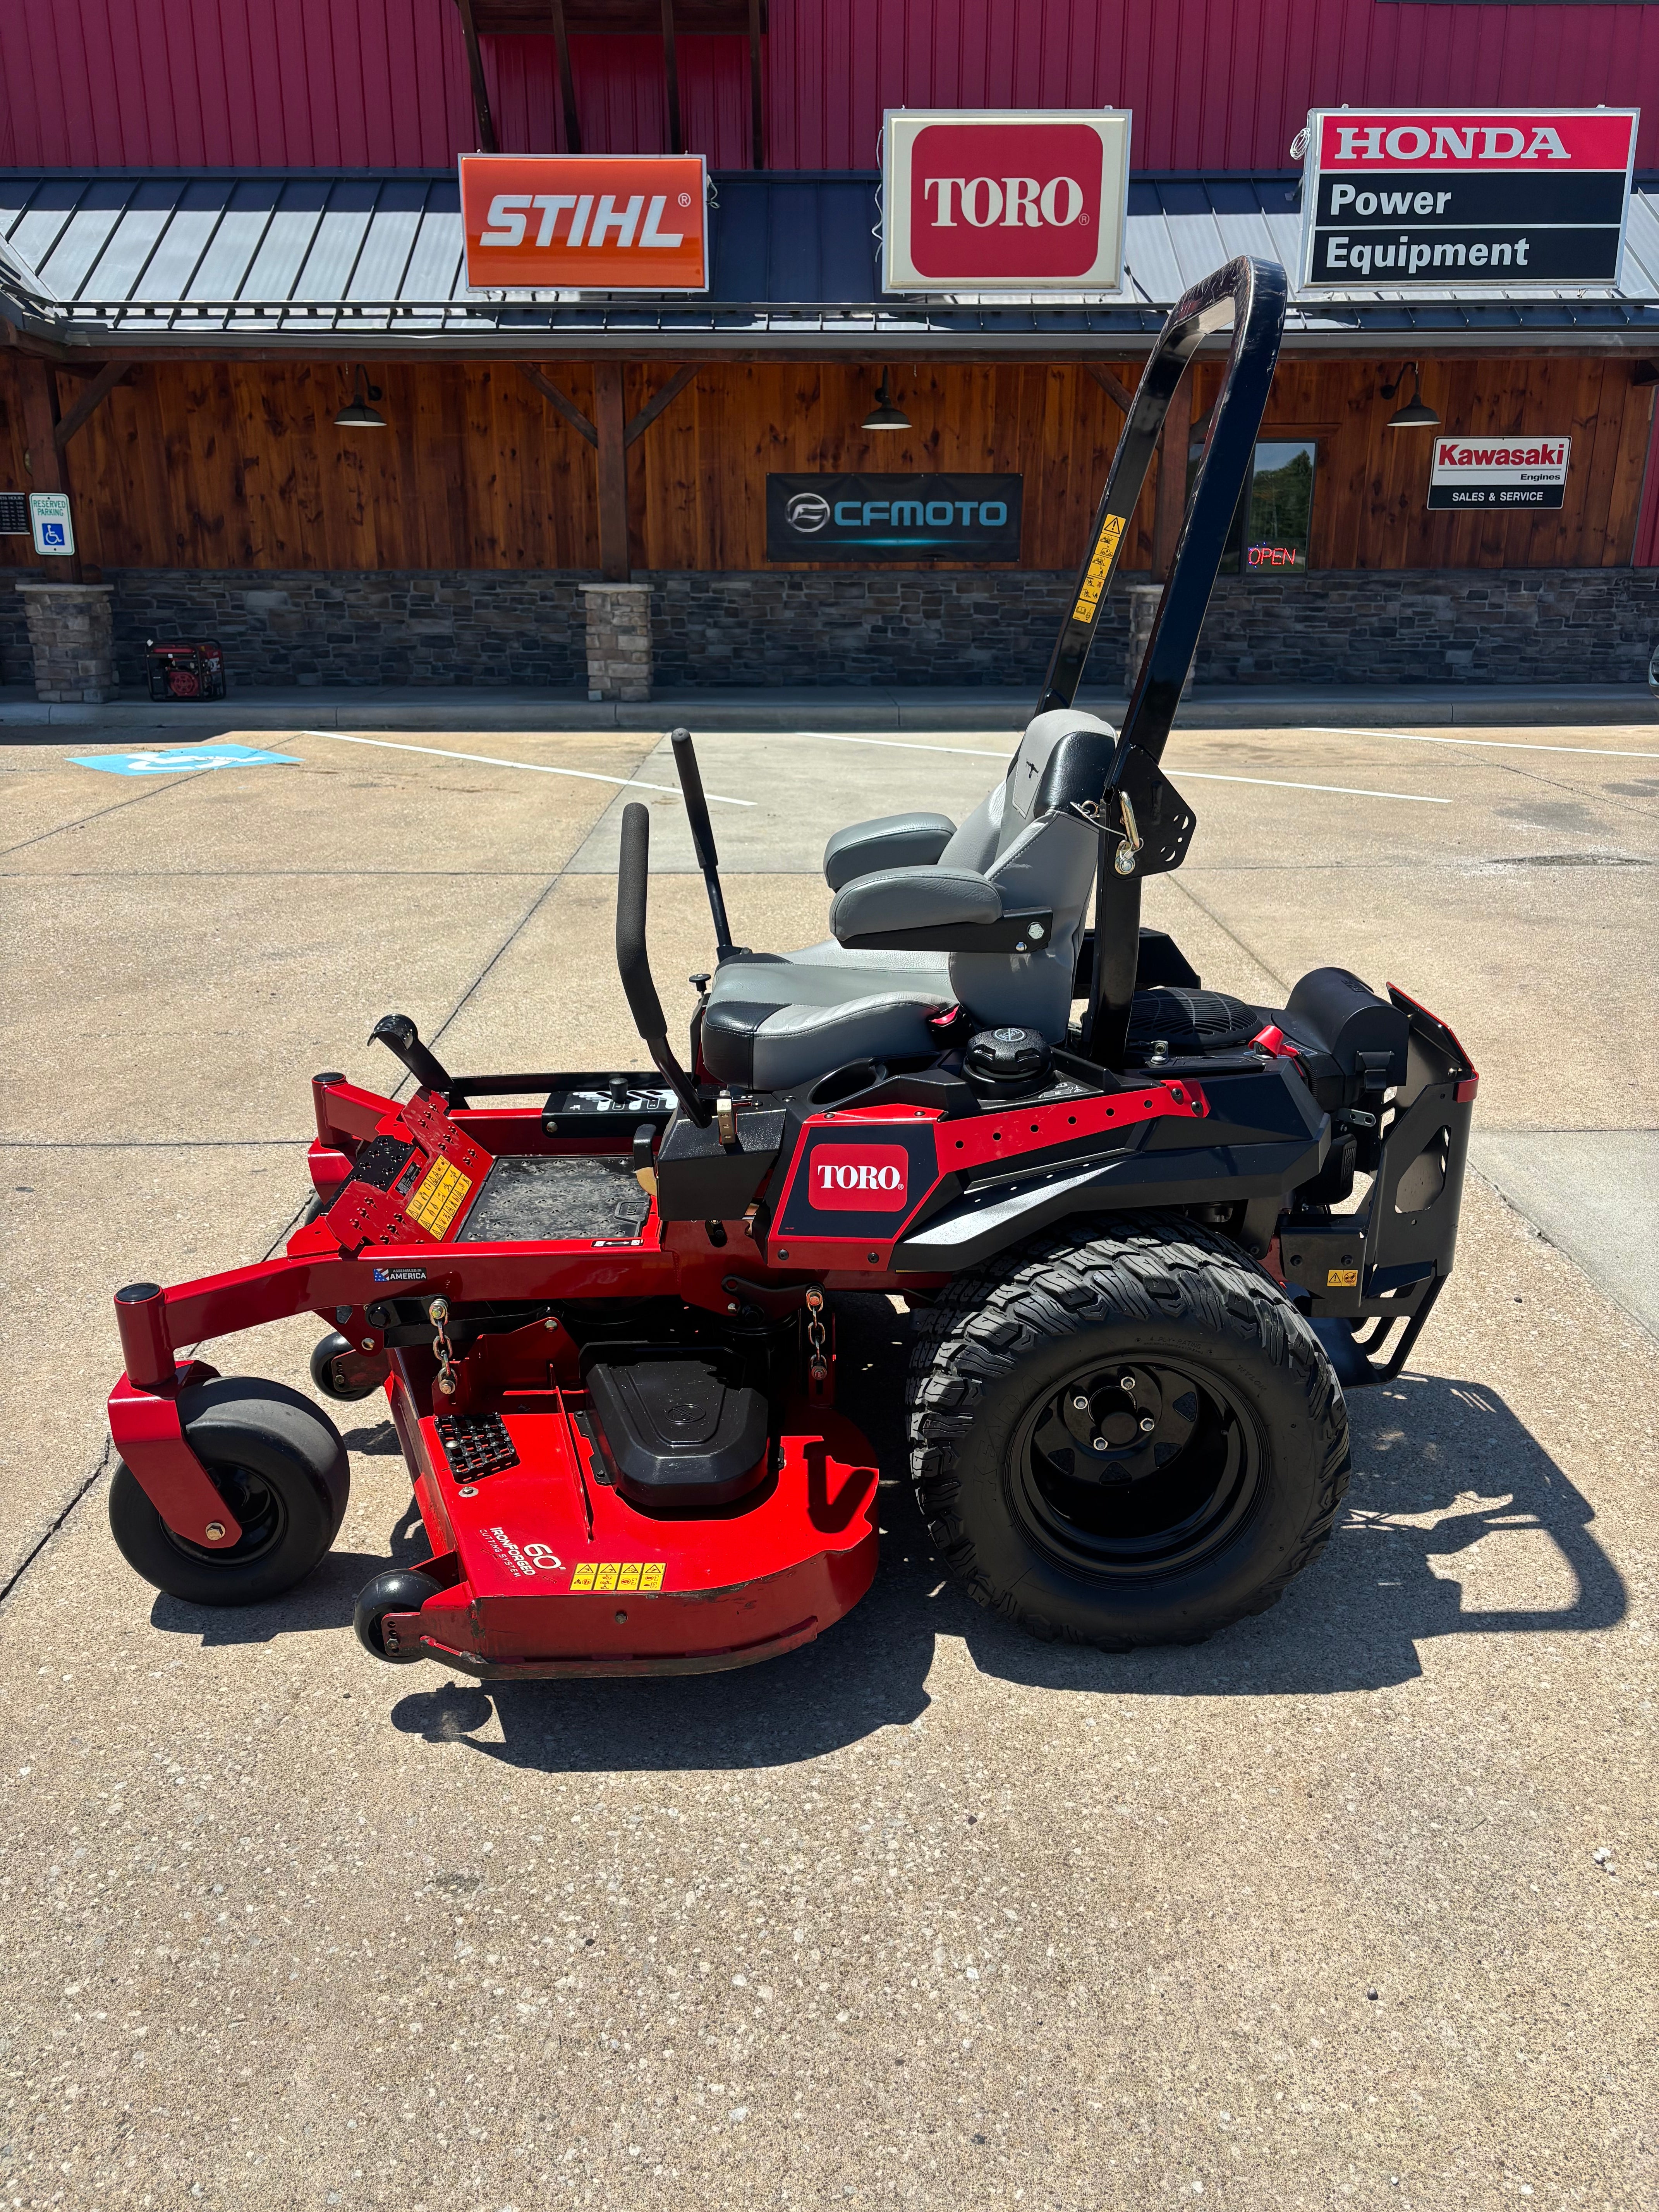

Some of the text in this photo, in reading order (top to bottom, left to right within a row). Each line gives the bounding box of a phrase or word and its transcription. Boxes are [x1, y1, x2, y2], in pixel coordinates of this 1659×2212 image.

[1334, 127, 1571, 159] HONDA
[924, 177, 1084, 227] TORO
[1330, 184, 1451, 215] Power
[479, 195, 684, 247] STIHL
[1326, 236, 1530, 275] Equipment
[1439, 444, 1564, 465] Kawasaki
[33, 500, 66, 508] RESERVED
[1452, 492, 1544, 501] SALES & SERVICE
[834, 501, 1007, 526] CFMOTO
[1248, 548, 1296, 565] OPEN
[817, 1165, 900, 1190] TORO
[1177, 1339, 1202, 1349] RATING
[479, 1529, 522, 1578] CUTTING SYSTEM
[489, 1527, 536, 1575] IRONFORGED
